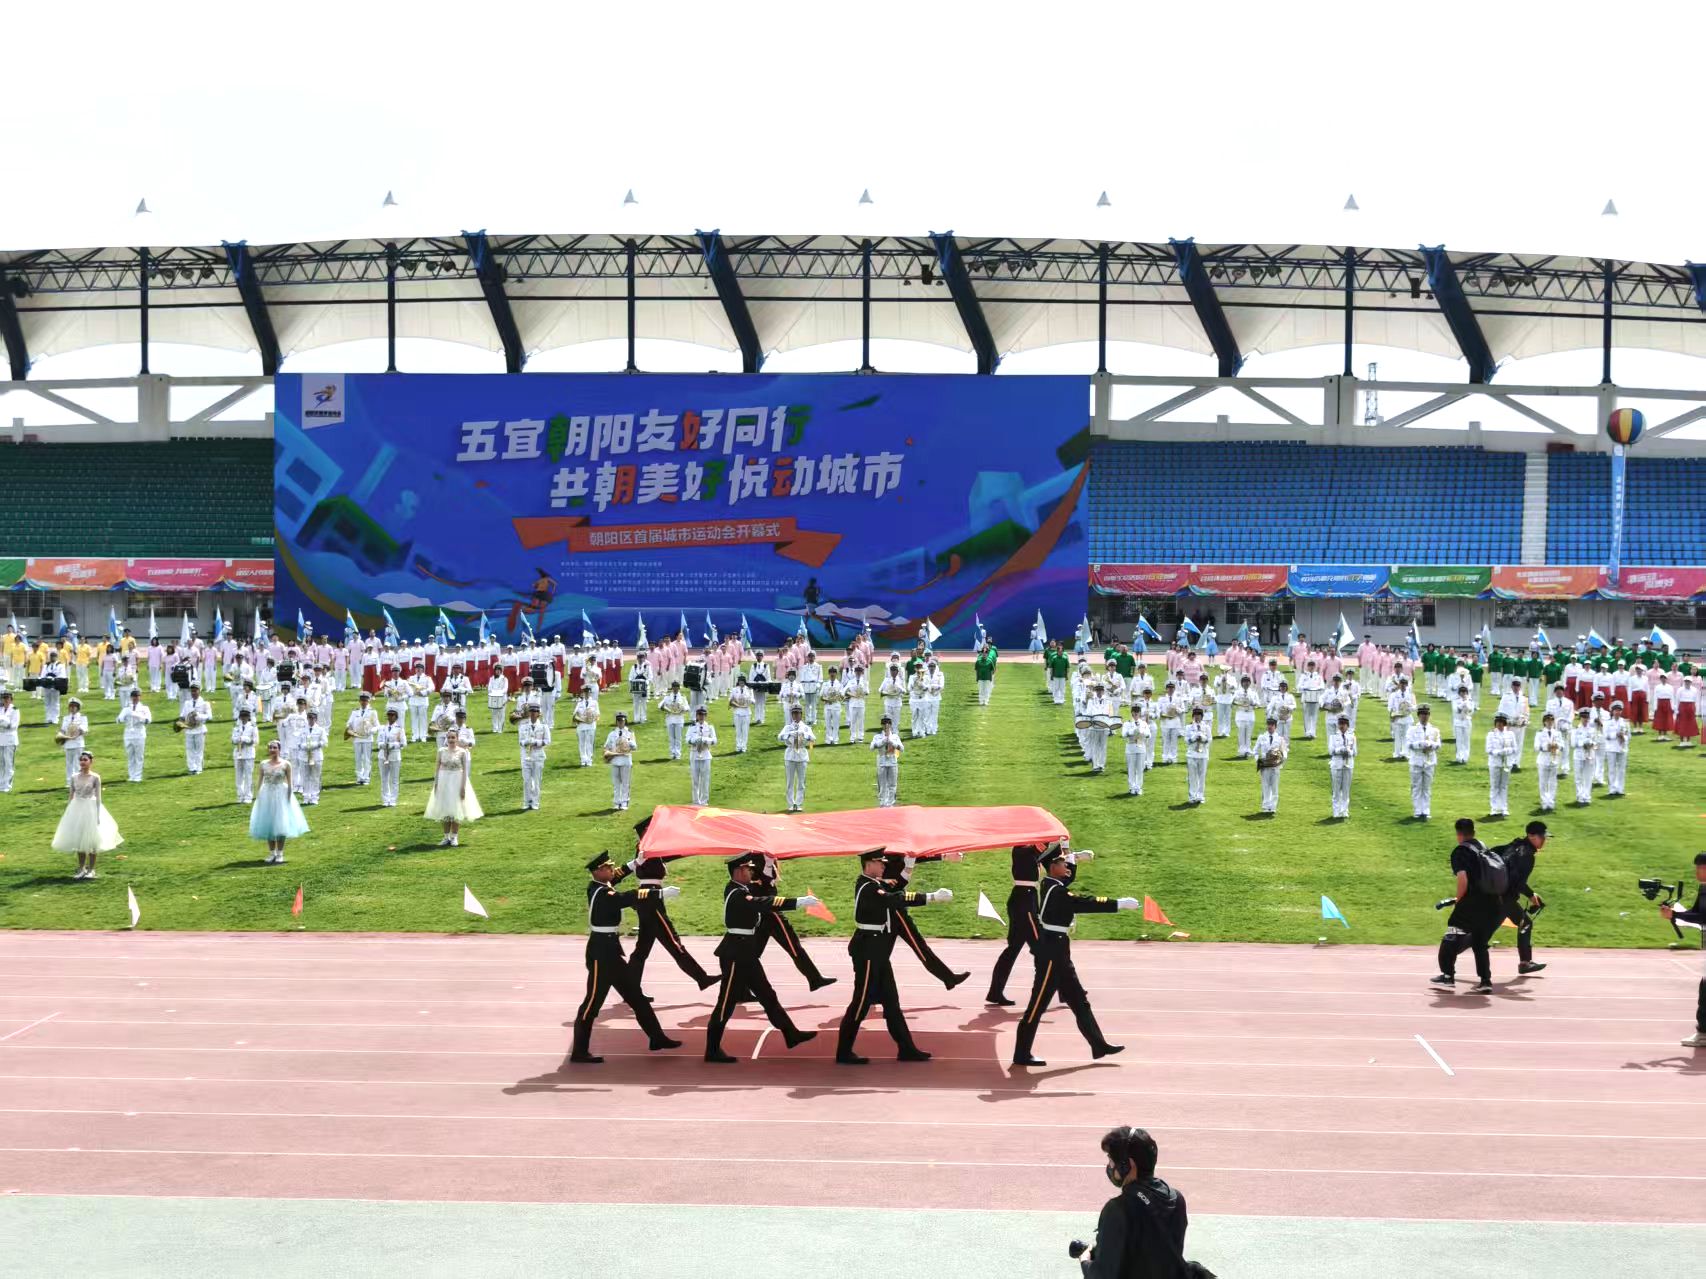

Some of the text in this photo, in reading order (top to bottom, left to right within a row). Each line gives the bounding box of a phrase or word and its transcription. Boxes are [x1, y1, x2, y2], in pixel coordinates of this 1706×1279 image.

[456, 405, 812, 463] 五宜朝阳友好同行
[550, 452, 904, 512] 共朝美好悦动城市
[590, 523, 781, 546] 朝阳区首届城市运动会开幕式
